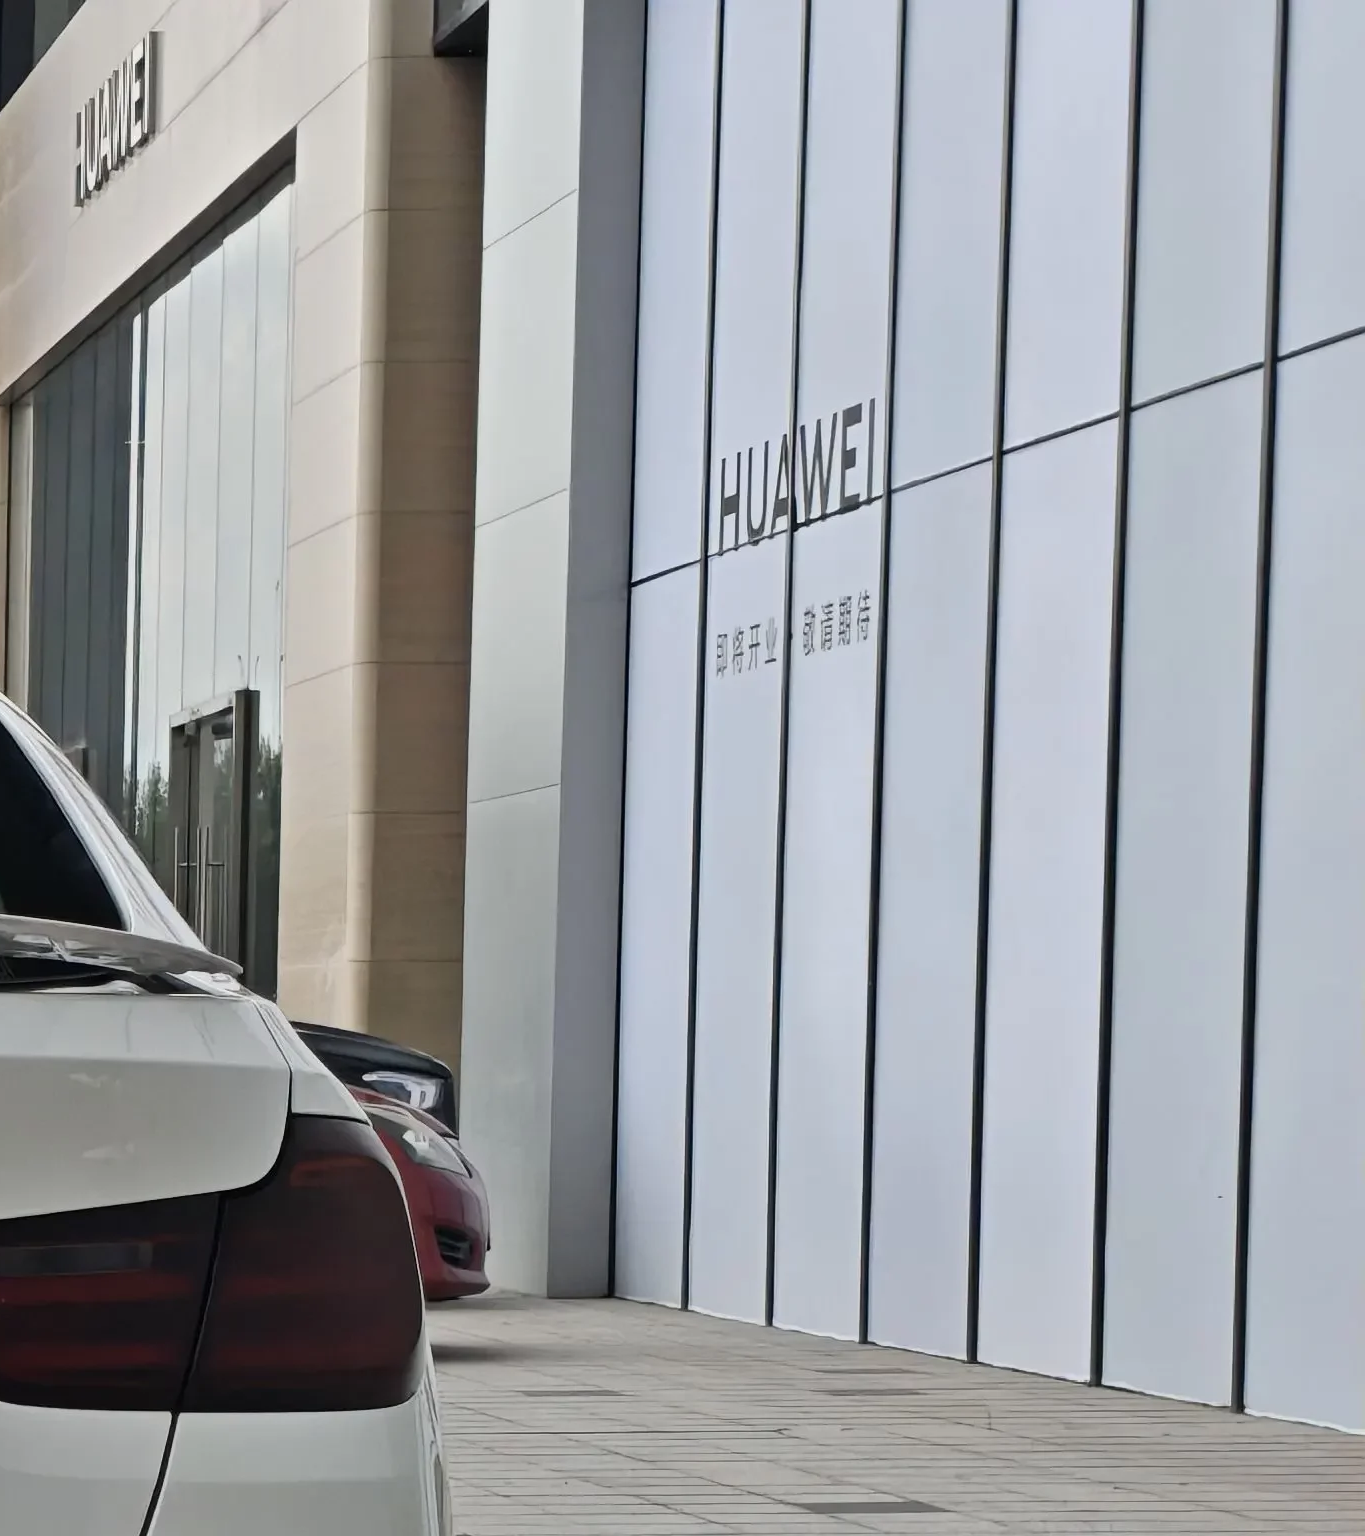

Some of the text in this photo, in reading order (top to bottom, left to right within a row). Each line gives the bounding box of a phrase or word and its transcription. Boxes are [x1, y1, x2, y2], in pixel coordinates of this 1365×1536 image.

[75, 30, 157, 207] HUAWEI
[718, 398, 876, 556] HUAWEI
[716, 589, 871, 678] 即将开业 敬请期待
